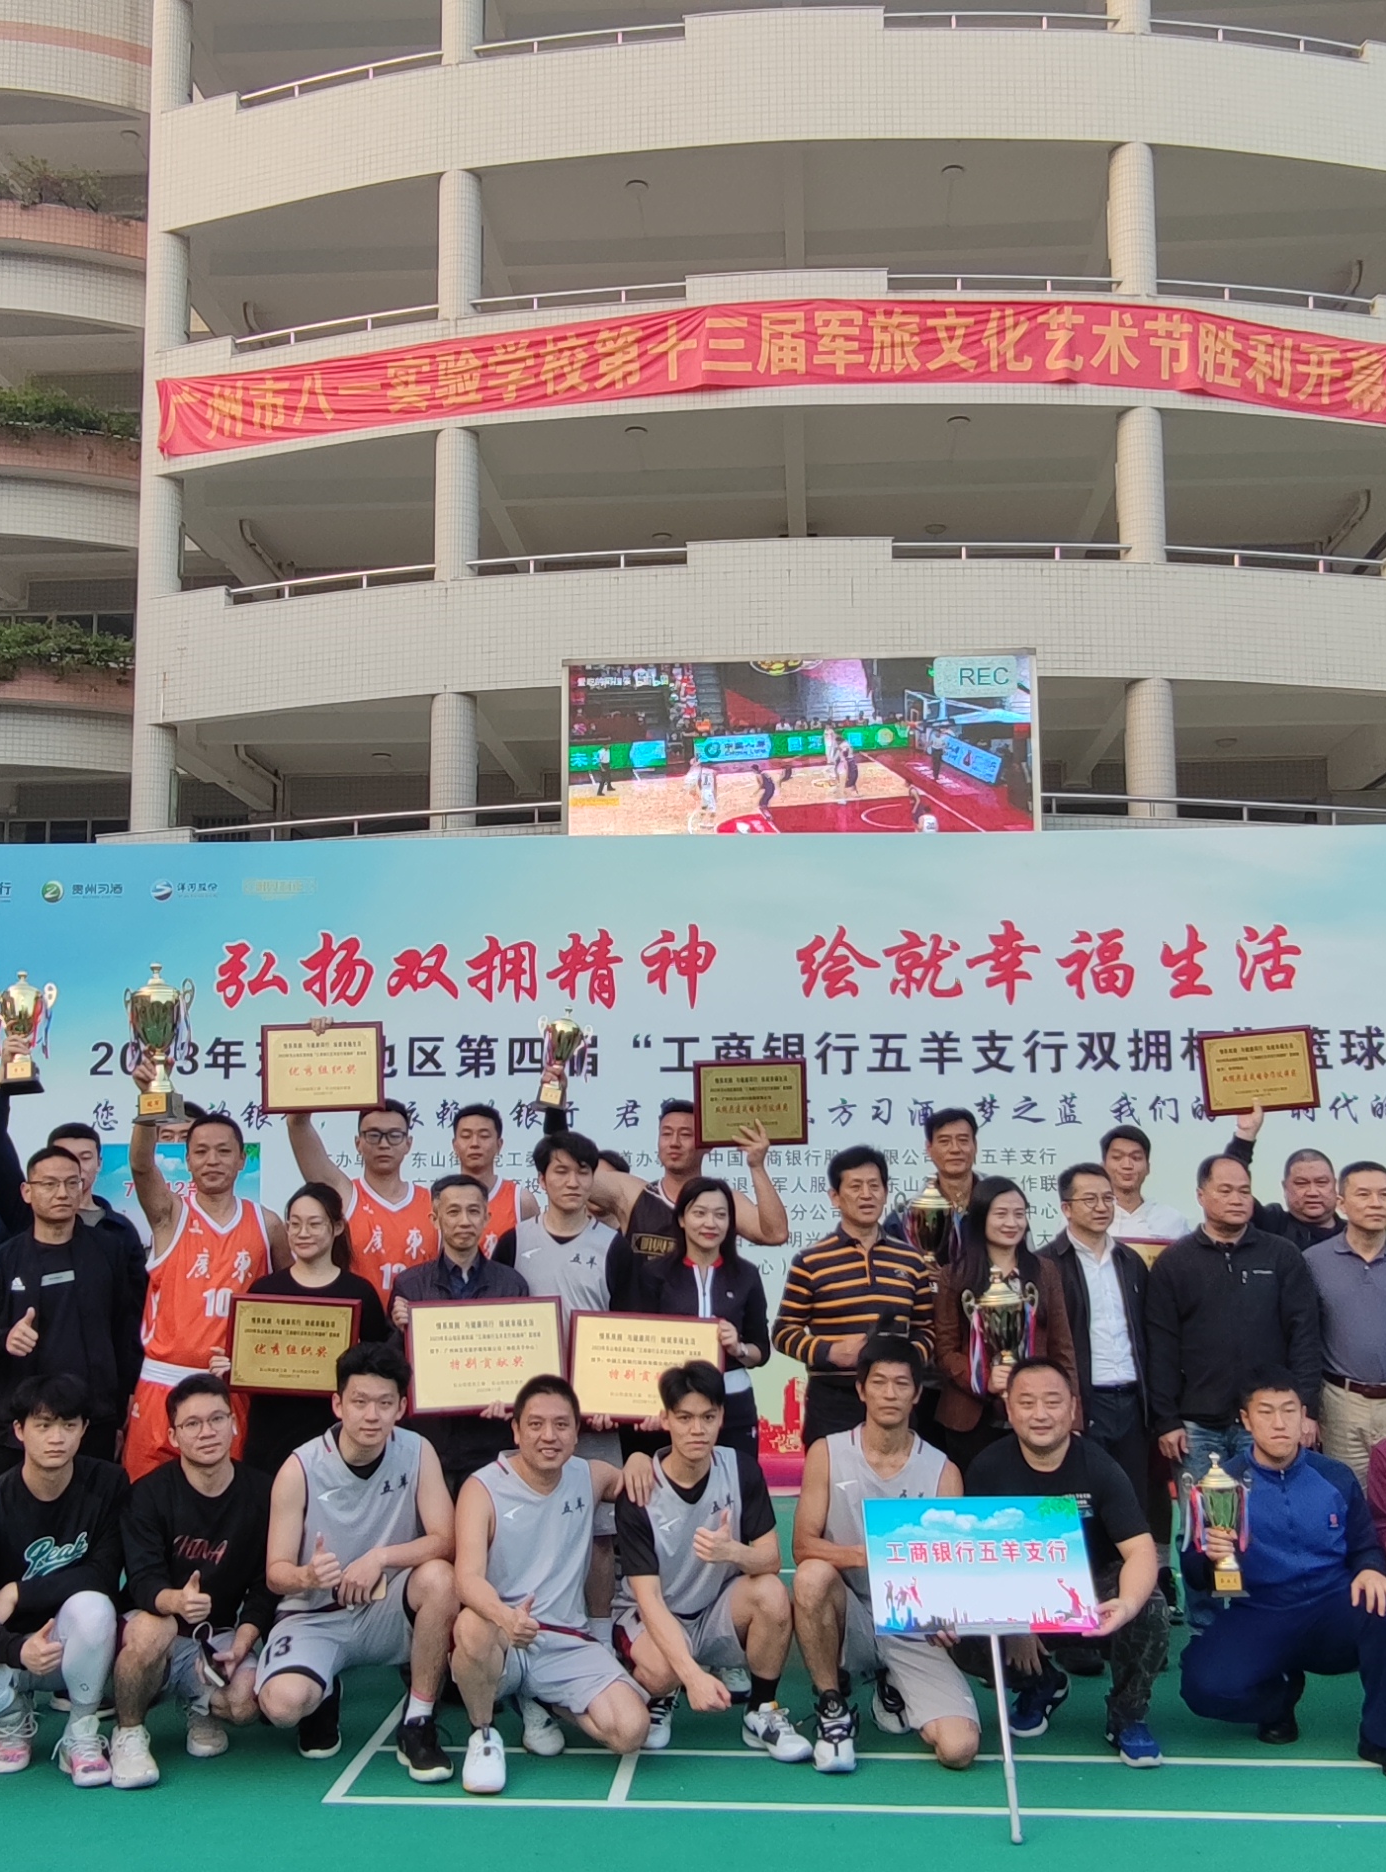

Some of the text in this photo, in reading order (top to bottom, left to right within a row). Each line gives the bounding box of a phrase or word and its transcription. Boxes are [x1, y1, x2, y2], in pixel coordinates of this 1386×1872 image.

[959, 667, 1009, 686] REC
[71, 882, 123, 896] 贵州习酒
[216, 919, 1302, 1010] 弘扬双拥精神 绘就幸福生活
[202, 1287, 231, 1318] 10
[254, 1342, 328, 1358] 优秀组织奖
[449, 1355, 525, 1371] 特别贡献奖
[381, 1474, 410, 1497] 五羊
[561, 1496, 585, 1517] 五羊
[886, 1539, 1069, 1564] 工商银行五羊支行
[264, 1635, 292, 1668] 13
